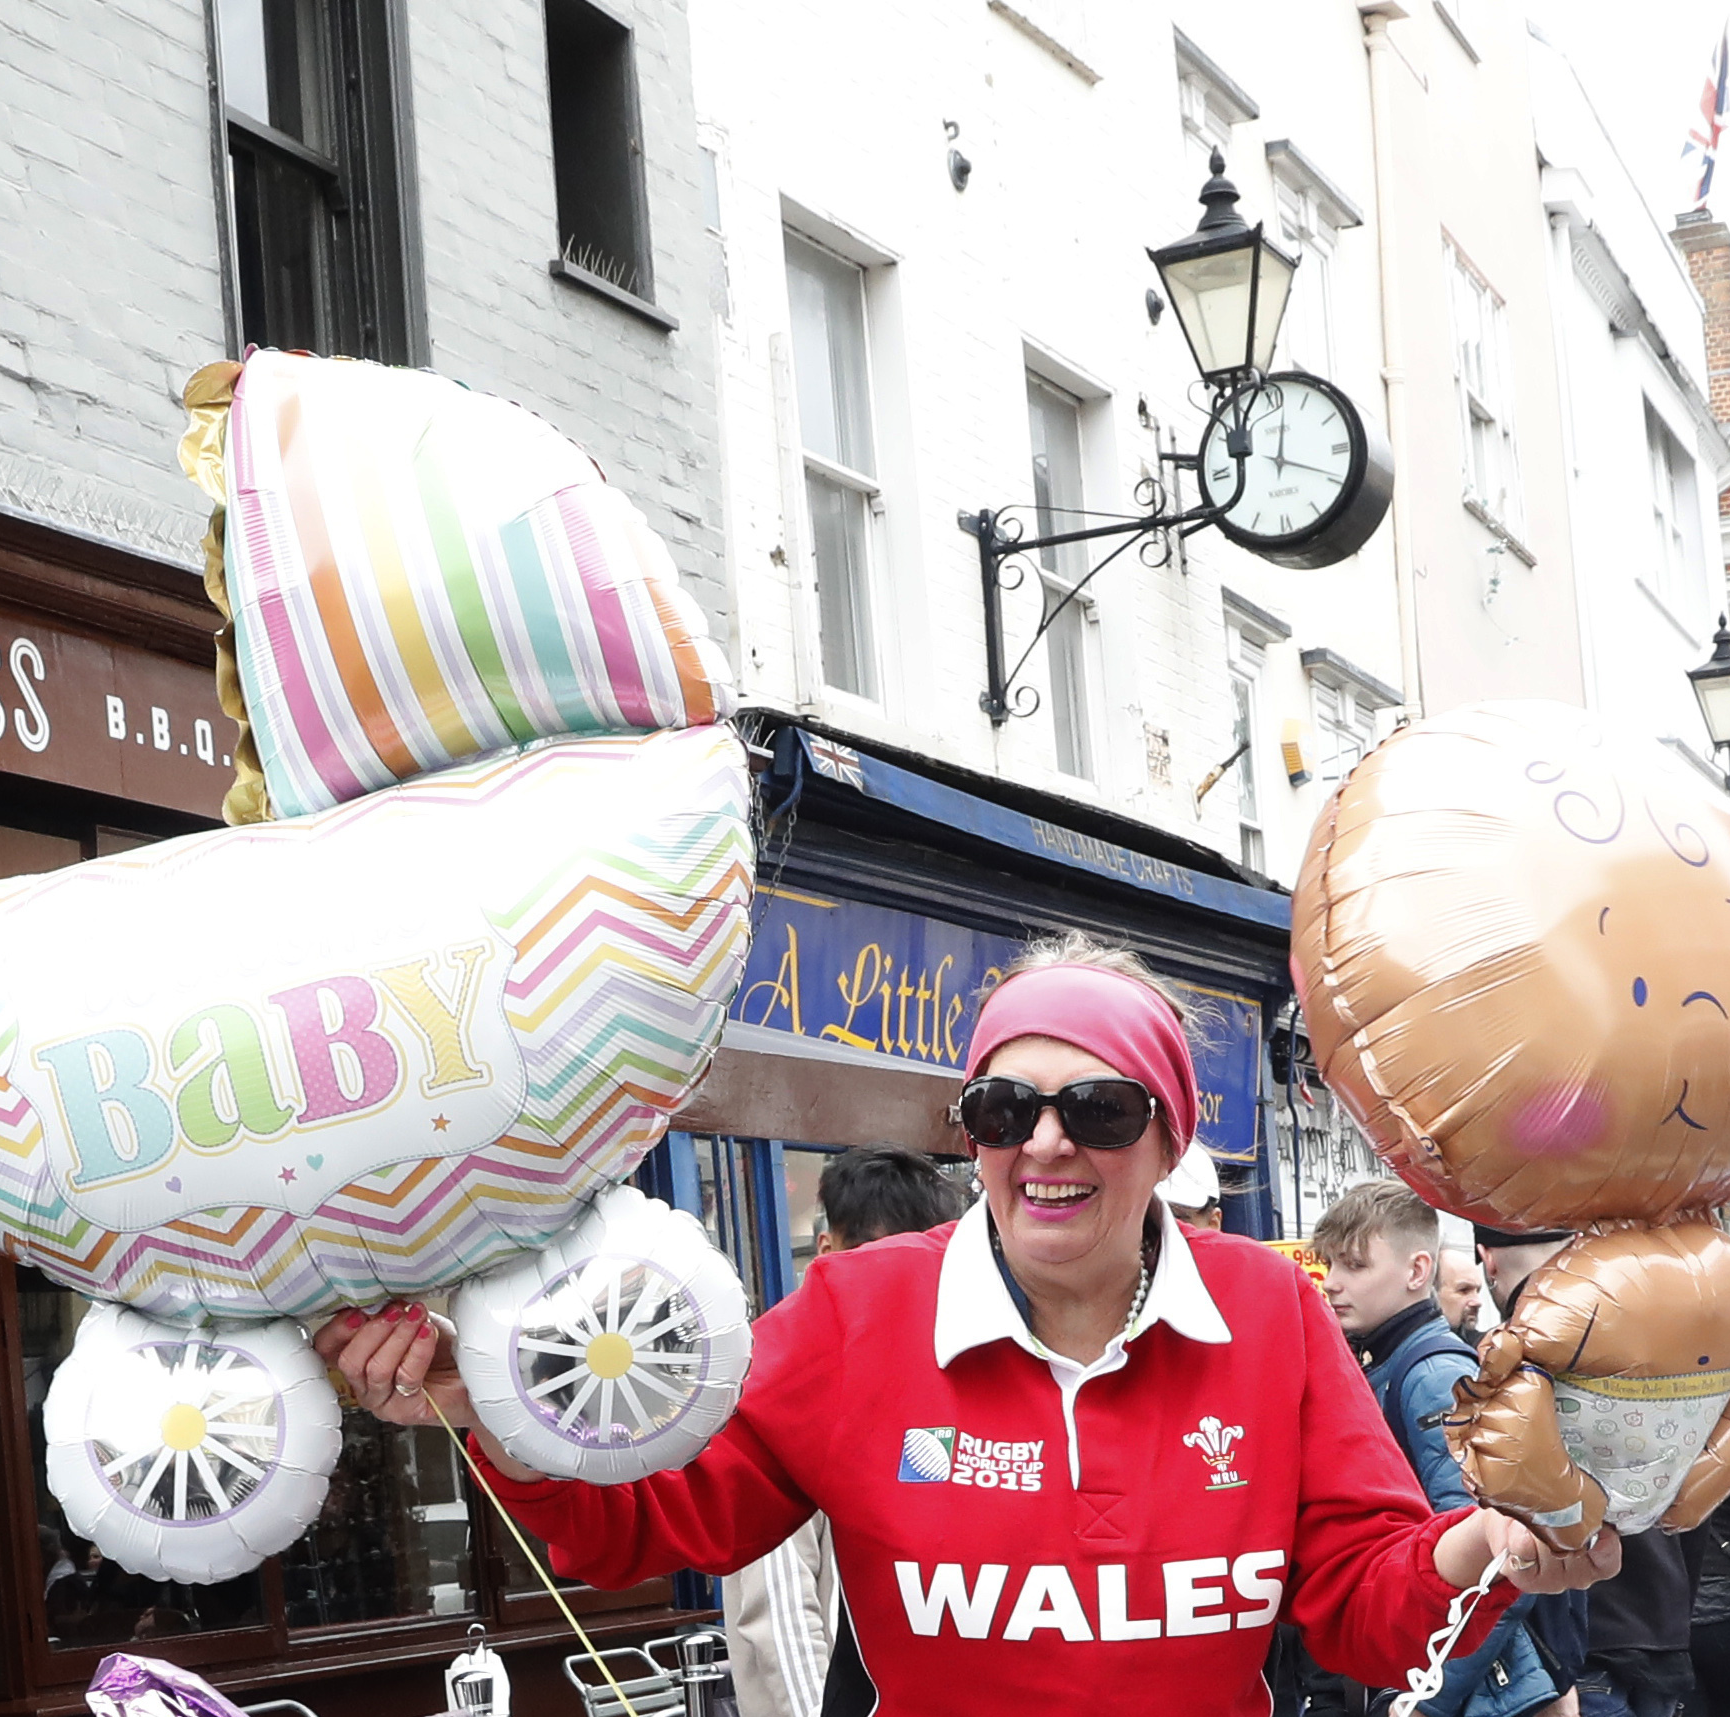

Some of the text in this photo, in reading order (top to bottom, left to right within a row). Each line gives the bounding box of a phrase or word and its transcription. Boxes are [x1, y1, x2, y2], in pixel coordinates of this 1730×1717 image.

[1029, 816, 1196, 896] HANDMADE CRAFTS
[739, 923, 965, 1065] A Little
[956, 1450, 1045, 1474] WORLD CUP
[957, 1431, 1045, 1462] RUGBY
[951, 1464, 1042, 1492] 2015
[1210, 1471, 1239, 1485] WRU
[893, 1549, 1286, 1643] WALES
